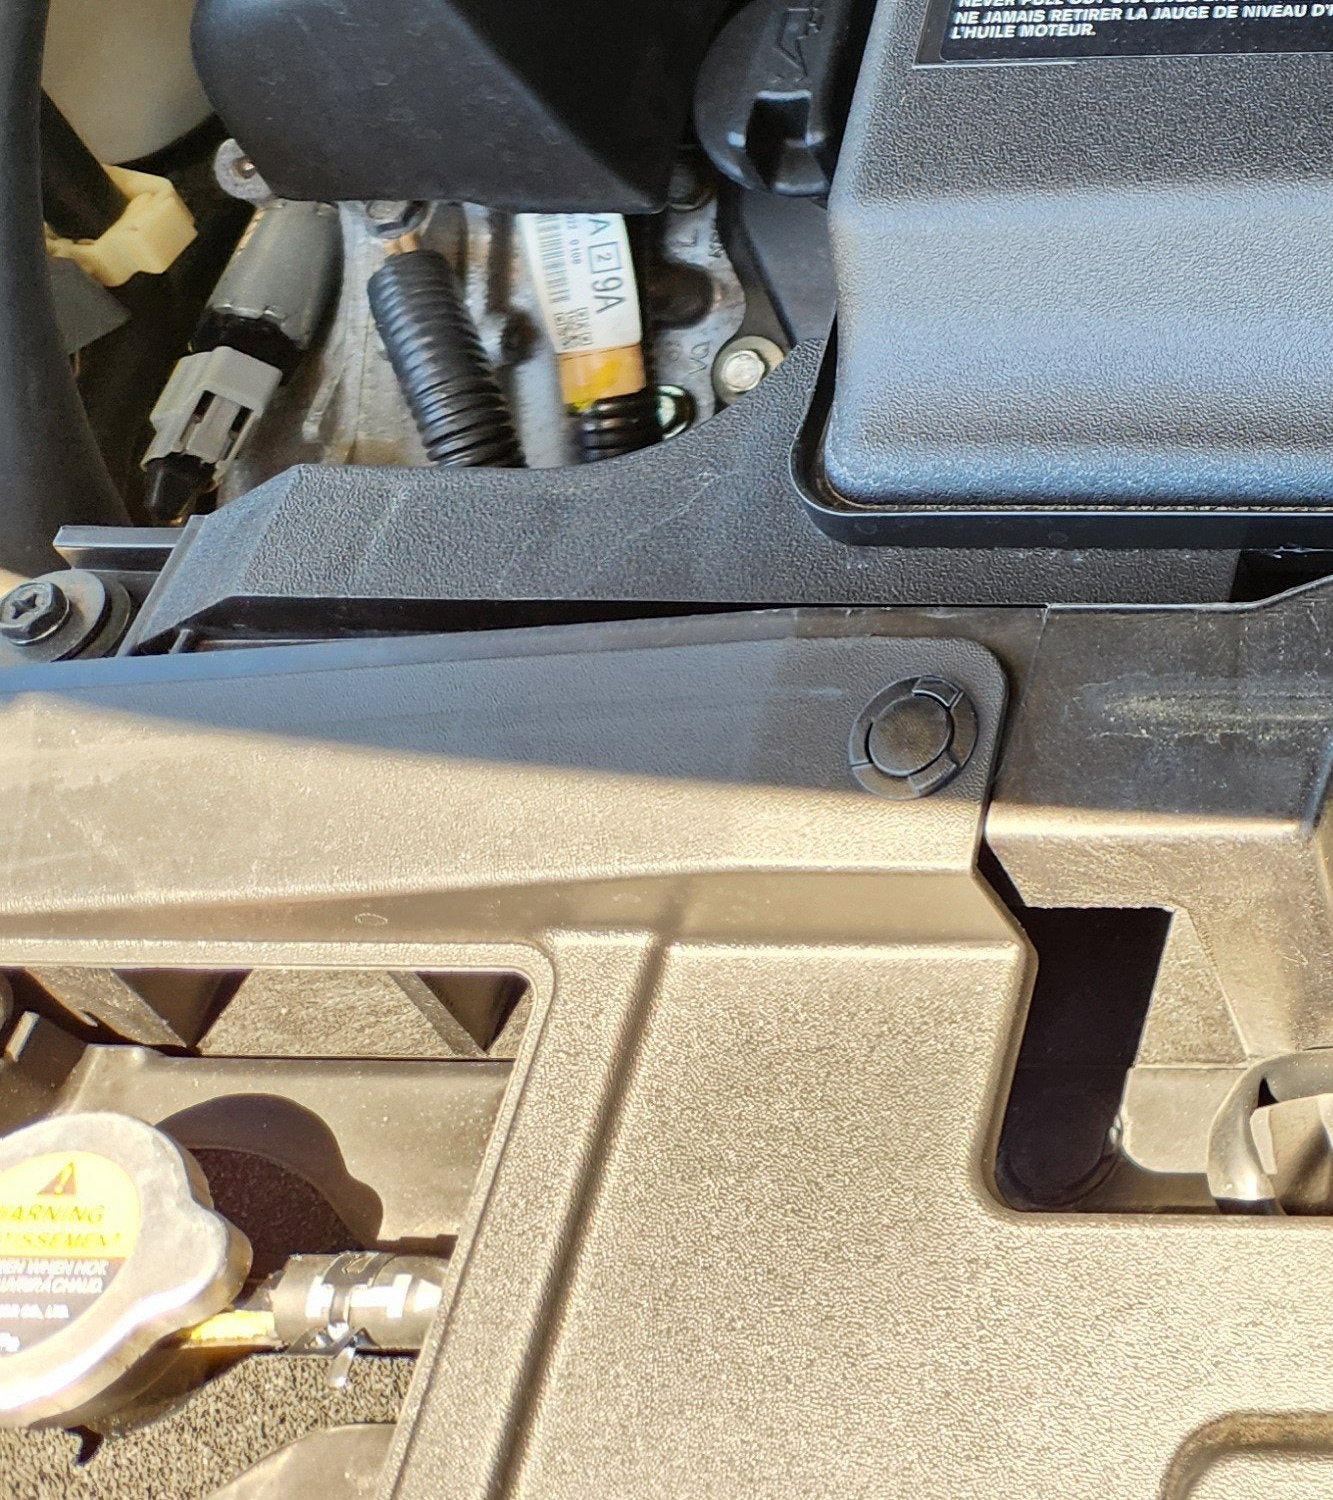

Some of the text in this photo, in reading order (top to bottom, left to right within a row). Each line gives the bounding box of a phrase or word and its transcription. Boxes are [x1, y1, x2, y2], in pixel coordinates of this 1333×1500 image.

[953, 11, 980, 25] NE
[982, 9, 1046, 24] JAMAIS
[1049, 8, 1123, 23] RETIRER
[1125, 7, 1148, 21] LA
[1151, 5, 1210, 20] JAUGE
[1213, 5, 1239, 19] DE
[1242, 4, 1307, 18] NIVEAU
[950, 23, 1097, 39] L'HUILE MOTEUR.
[592, 276, 627, 314] 9A
